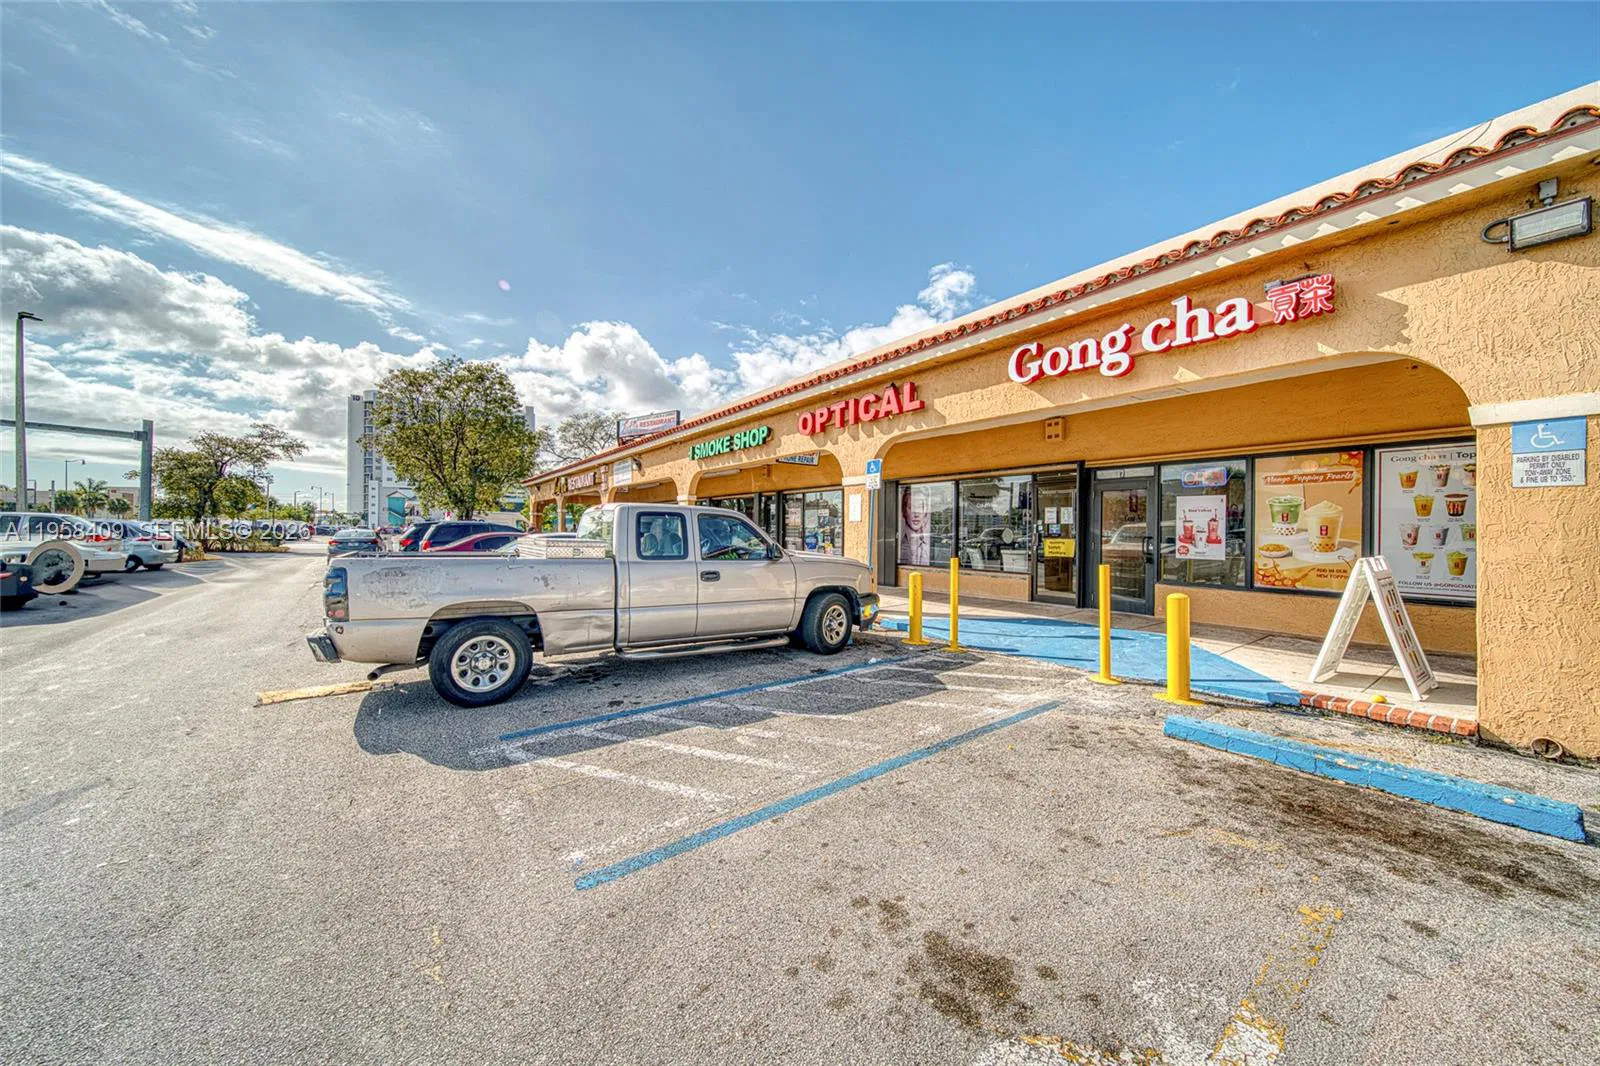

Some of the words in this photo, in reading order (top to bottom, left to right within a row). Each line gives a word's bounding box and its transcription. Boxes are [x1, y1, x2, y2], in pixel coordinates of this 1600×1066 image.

[1007, 323, 1135, 384] Gong
[1141, 295, 1258, 352] cha
[798, 381, 925, 436] OPTICAL
[694, 437, 732, 459] SMOKE
[733, 425, 770, 450] SHOP
[798, 455, 815, 464] REPAIR
[1390, 455, 1417, 463] Gong
[1418, 453, 1437, 461] cha
[1551, 453, 1580, 461] DISABLED
[1293, 473, 1324, 482] Popping
